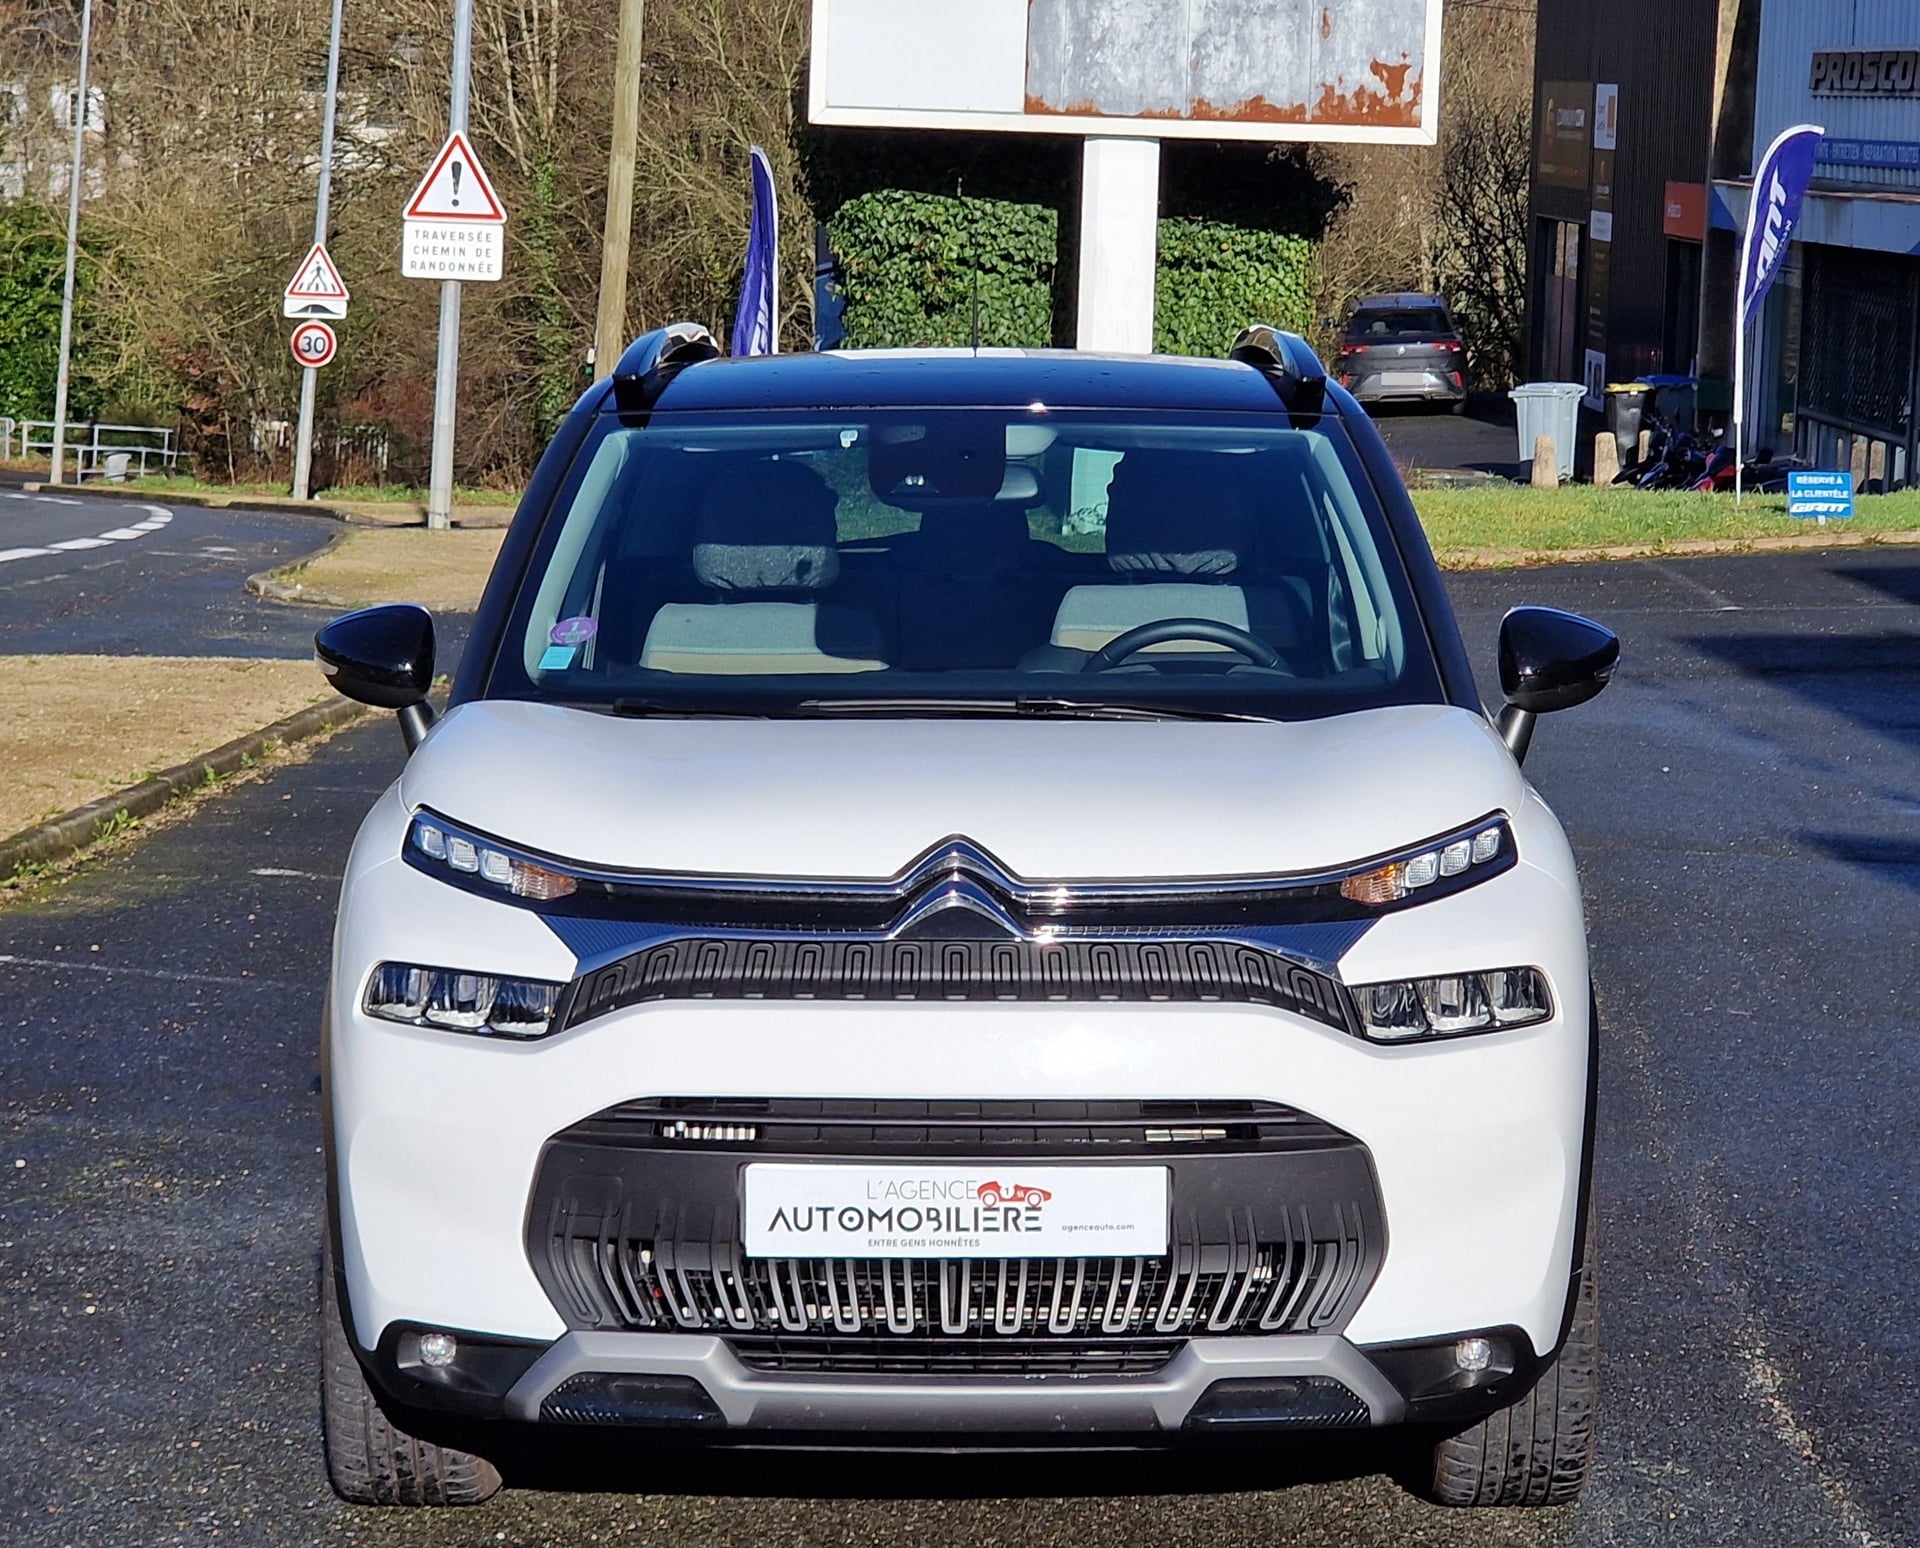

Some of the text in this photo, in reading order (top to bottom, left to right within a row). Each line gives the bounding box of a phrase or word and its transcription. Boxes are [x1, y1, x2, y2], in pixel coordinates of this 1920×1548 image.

[414, 229, 492, 243] TRAVERSÉE
[413, 245, 492, 258] CHEMIN DE
[410, 260, 494, 274] RANDONNÉE
[302, 335, 326, 354] 30
[1791, 490, 1803, 498] LA
[867, 1180, 977, 1200] L'AGENCE
[1061, 1223, 1135, 1233] agenceauto.com
[868, 1237, 980, 1248] ENTRE GENS HONNÊTES
